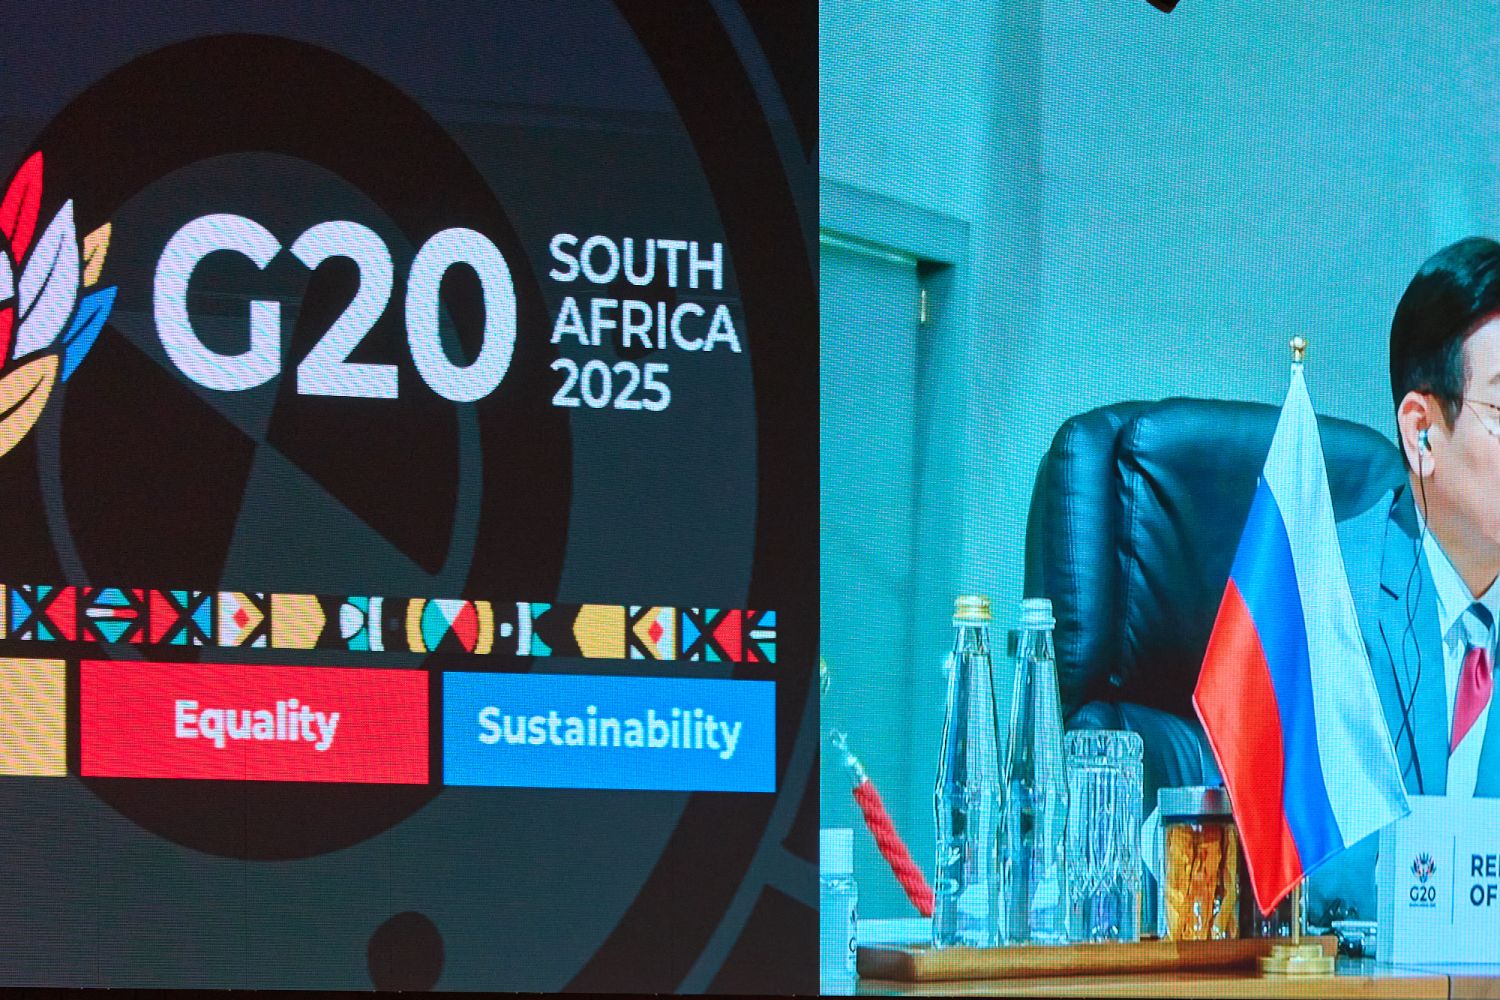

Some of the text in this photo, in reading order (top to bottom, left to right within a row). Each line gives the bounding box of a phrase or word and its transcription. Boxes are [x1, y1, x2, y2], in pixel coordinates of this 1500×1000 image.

[549, 233, 724, 291] SOUTH
[153, 213, 517, 402] G20
[551, 297, 742, 353] AFRICA
[551, 359, 672, 412] 2025
[174, 699, 340, 752] Equality
[478, 706, 742, 760] Sustainability
[1409, 886, 1436, 902] G20
[1470, 884, 1498, 907] OF
